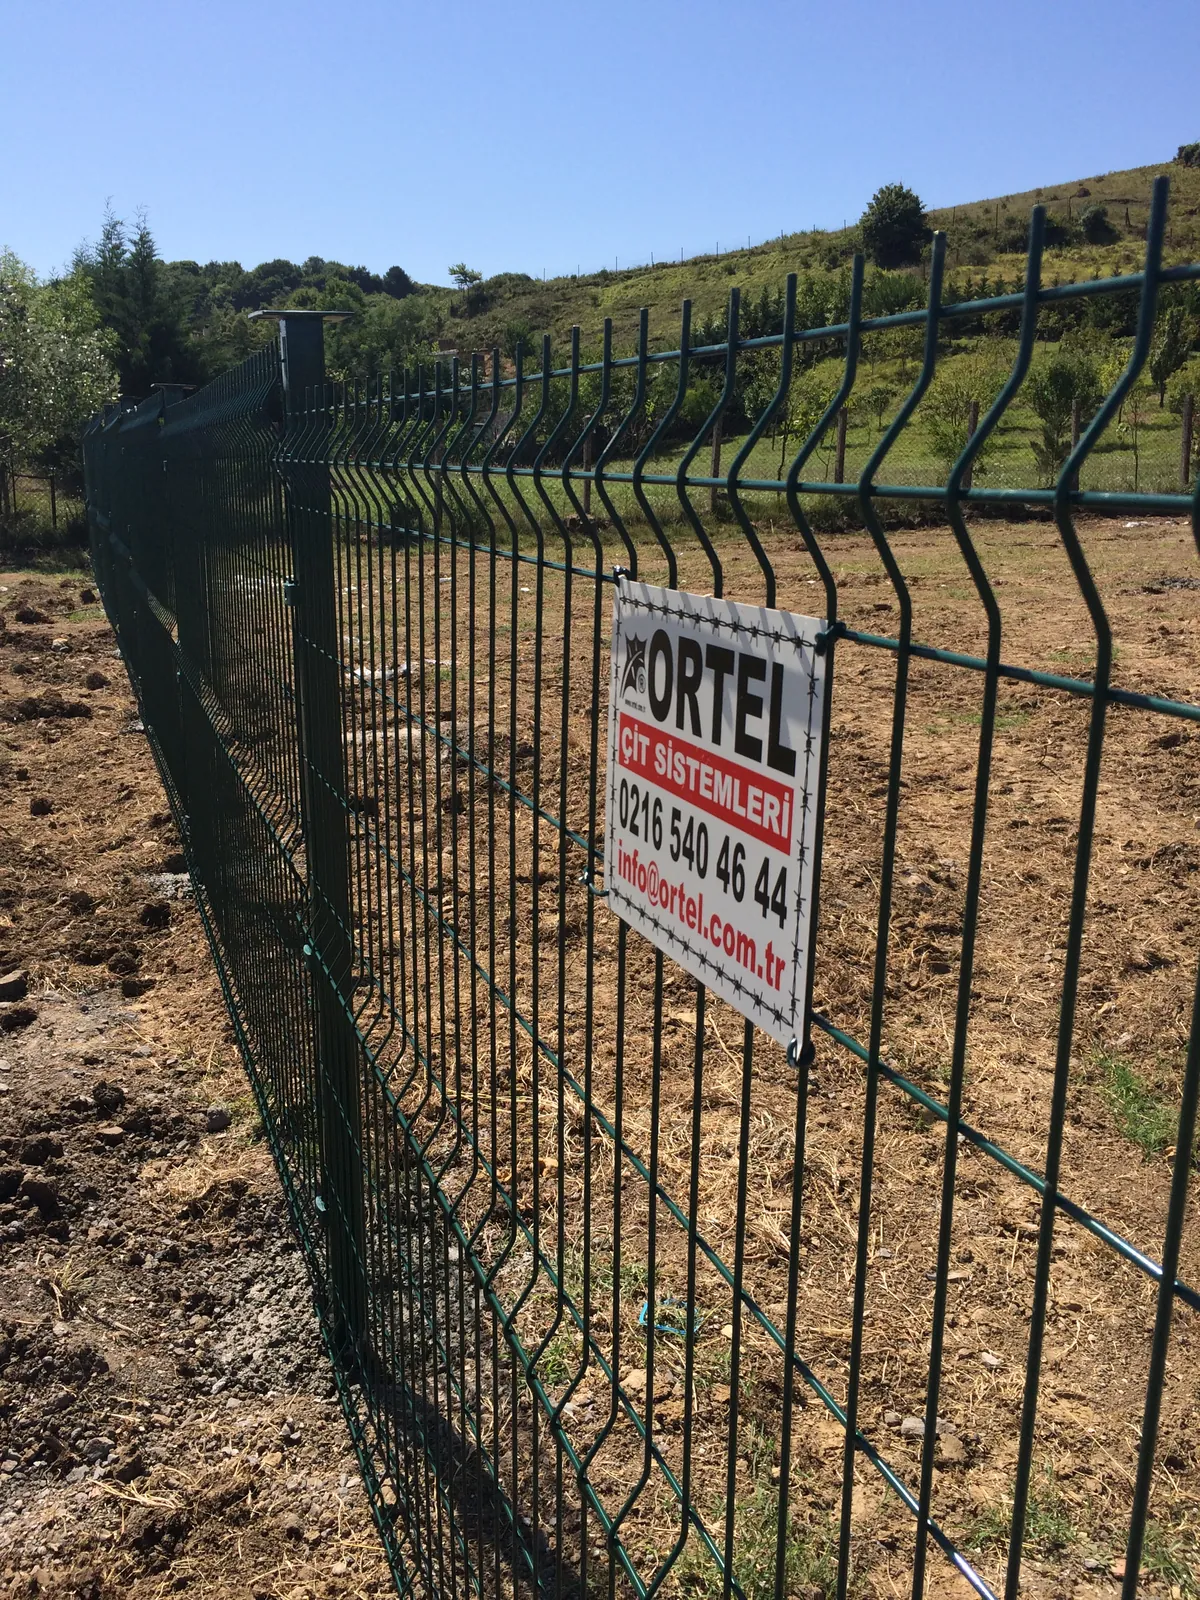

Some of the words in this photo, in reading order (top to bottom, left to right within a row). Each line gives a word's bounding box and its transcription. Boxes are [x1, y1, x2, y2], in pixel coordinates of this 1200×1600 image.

[648, 629, 796, 777] ORTEL
[619, 778, 663, 850] 0216
[670, 806, 709, 879] 540
[716, 835, 746, 903] 46
[754, 857, 787, 930] 44
[621, 724, 650, 766] ÇİT
[654, 740, 790, 839] SİSTEMLERİ
[618, 839, 786, 992] info@ortel.com.tr
